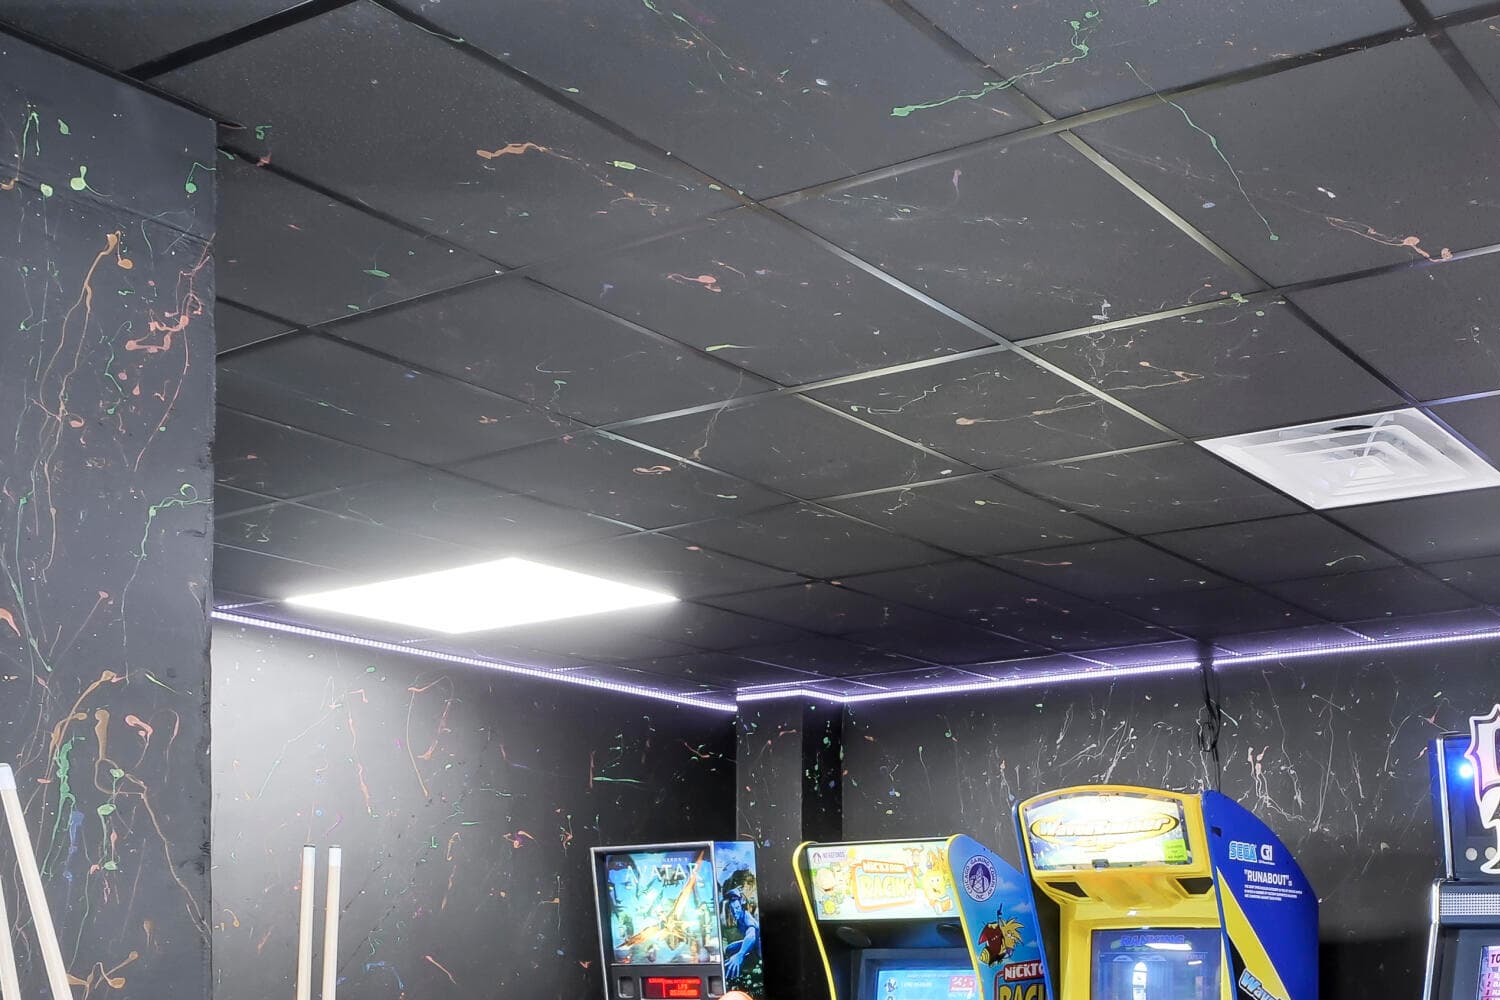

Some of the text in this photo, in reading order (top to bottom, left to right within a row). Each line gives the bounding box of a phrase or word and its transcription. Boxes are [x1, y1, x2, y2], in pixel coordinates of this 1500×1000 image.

[970, 857, 990, 867] GAMING
[1228, 840, 1258, 863] SEGA
[625, 862, 705, 884] AVATAR
[859, 874, 914, 898] RACING
